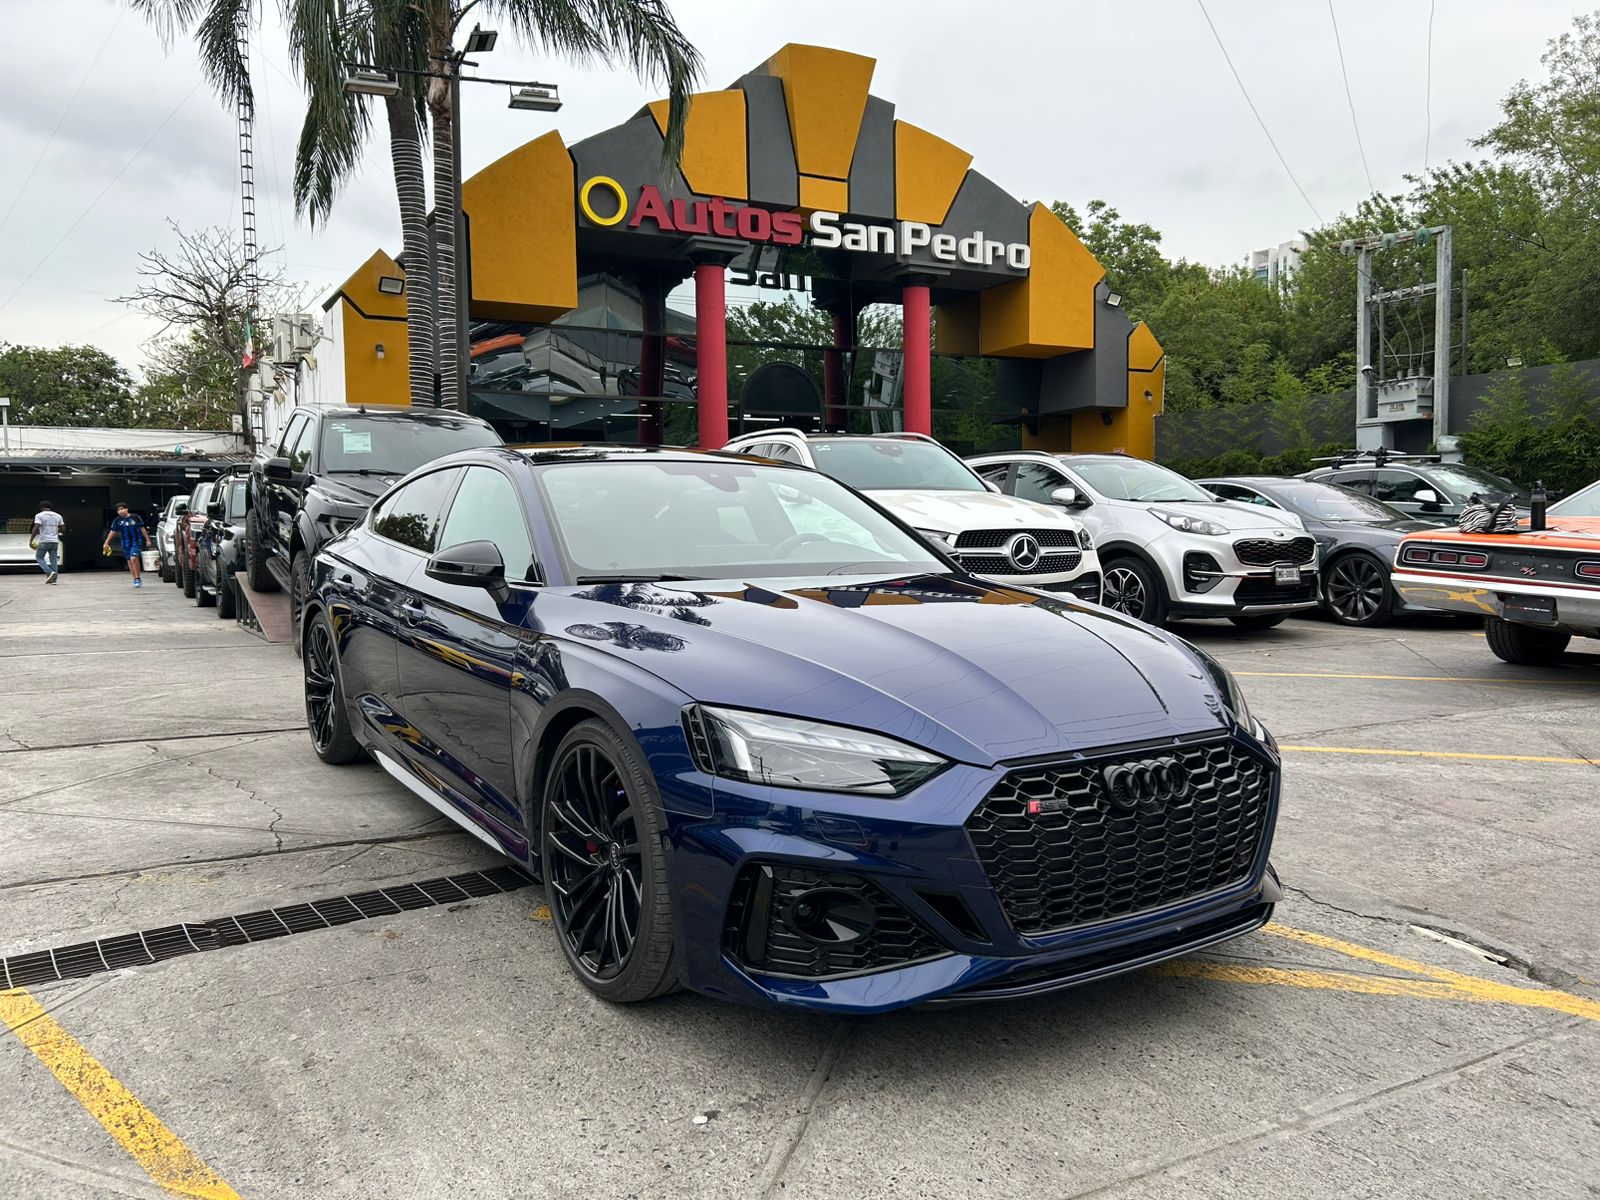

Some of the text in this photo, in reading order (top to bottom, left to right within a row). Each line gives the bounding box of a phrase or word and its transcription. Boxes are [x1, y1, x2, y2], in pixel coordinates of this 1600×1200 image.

[628, 185, 1031, 269] Autos San Pedro
